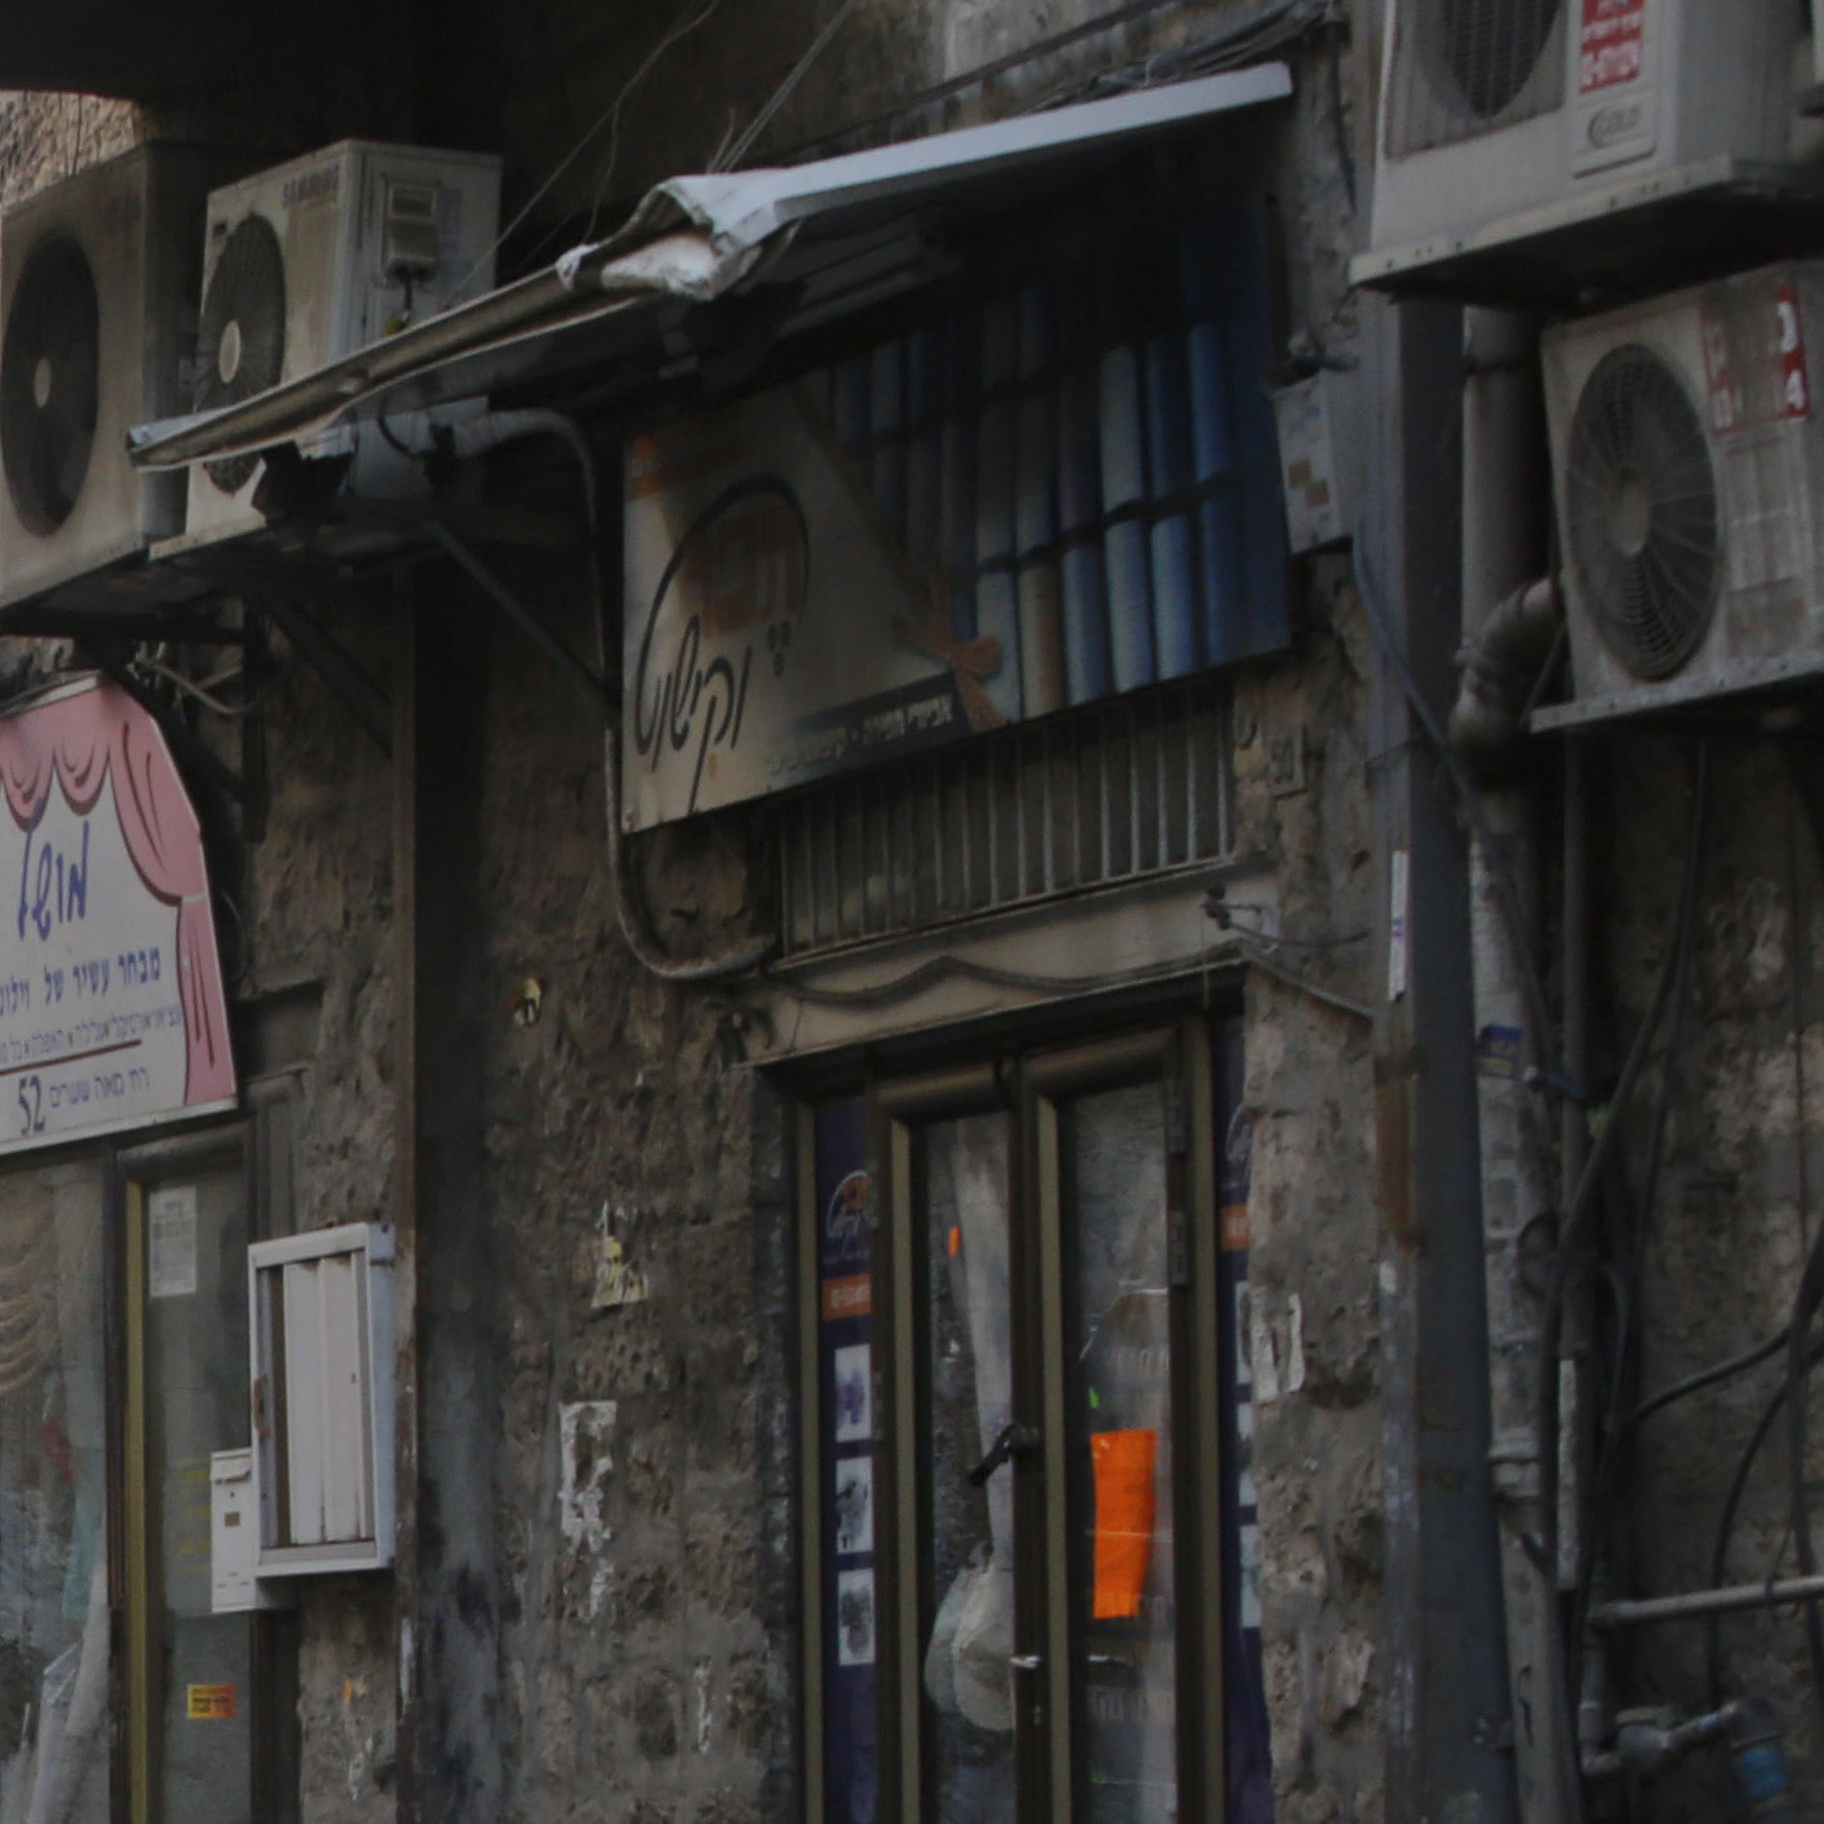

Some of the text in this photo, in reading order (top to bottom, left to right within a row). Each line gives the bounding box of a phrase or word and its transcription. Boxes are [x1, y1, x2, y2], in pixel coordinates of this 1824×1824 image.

[72, 959, 110, 997] עשיר
[117, 947, 160, 982] מבחר
[44, 965, 64, 1006] של
[49, 1079, 91, 1108] שערים
[93, 1073, 126, 1099] מאה
[18, 1074, 46, 1136] 52
